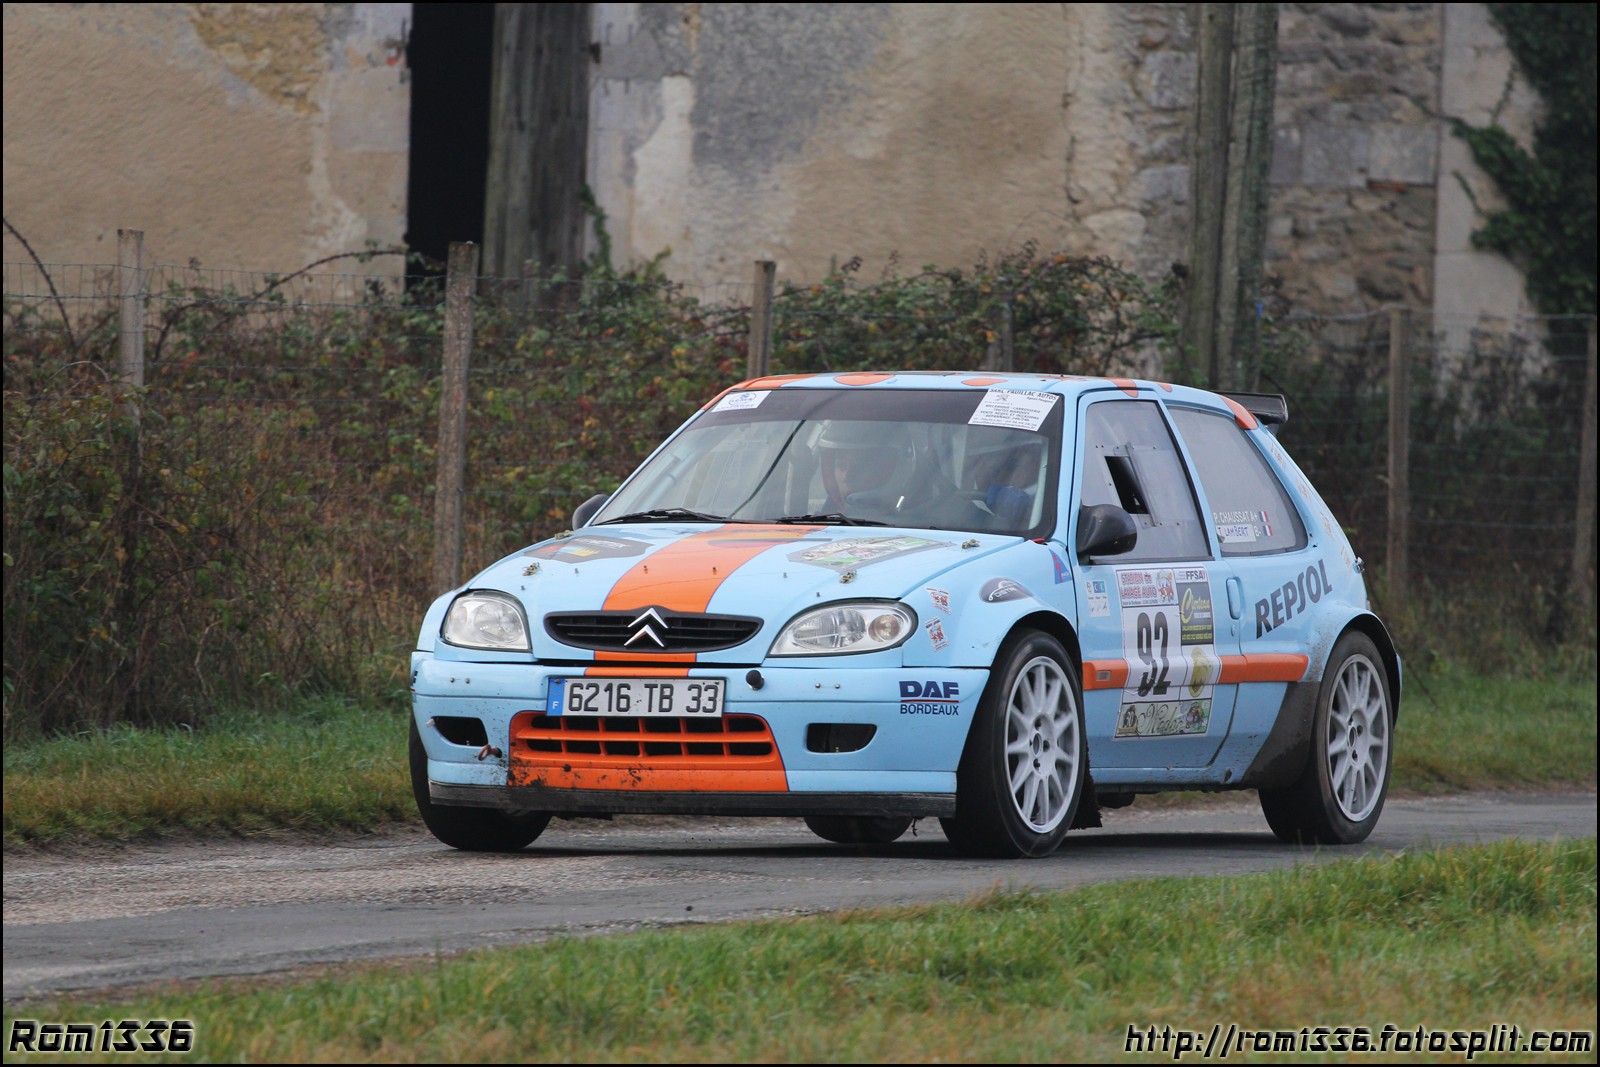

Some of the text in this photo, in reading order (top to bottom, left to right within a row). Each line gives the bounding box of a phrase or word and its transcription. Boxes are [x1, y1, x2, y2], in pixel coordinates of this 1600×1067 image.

[1038, 392, 1058, 401] AUTOS
[1186, 570, 1204, 580] FFSA
[1120, 585, 1141, 600] LAVAGE
[1142, 585, 1158, 598] AUTO
[1255, 558, 1333, 639] REPSOL
[1137, 611, 1171, 697] 92
[899, 680, 960, 698] DAF
[552, 701, 559, 709] F
[568, 682, 719, 714] 6216 TB 33
[900, 703, 959, 716] BORDEAUX
